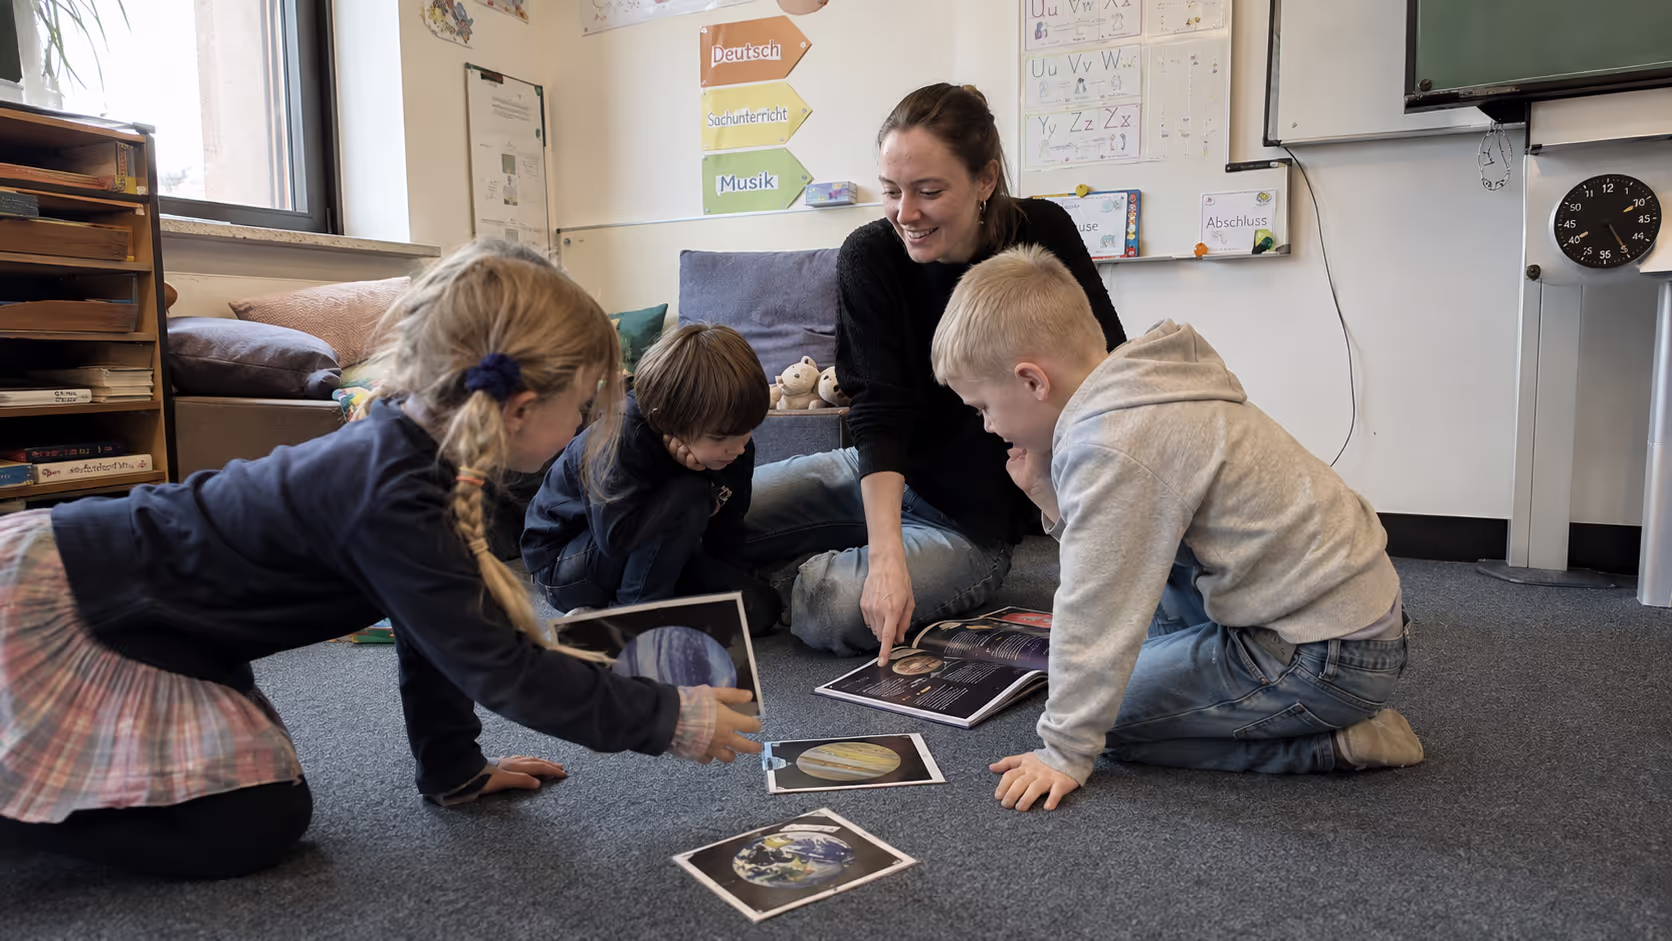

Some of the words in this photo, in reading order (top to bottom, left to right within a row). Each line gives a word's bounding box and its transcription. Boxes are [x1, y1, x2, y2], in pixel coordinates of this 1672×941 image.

[713, 39, 780, 64] Deutsch
[707, 105, 788, 127] Sachunterricht
[720, 171, 775, 192] Musik
[1602, 183, 1614, 193] 12
[1078, 222, 1099, 233] use
[1205, 214, 1268, 229] Abschluss
[1563, 219, 1576, 228] 45
[1568, 236, 1580, 244] 40
